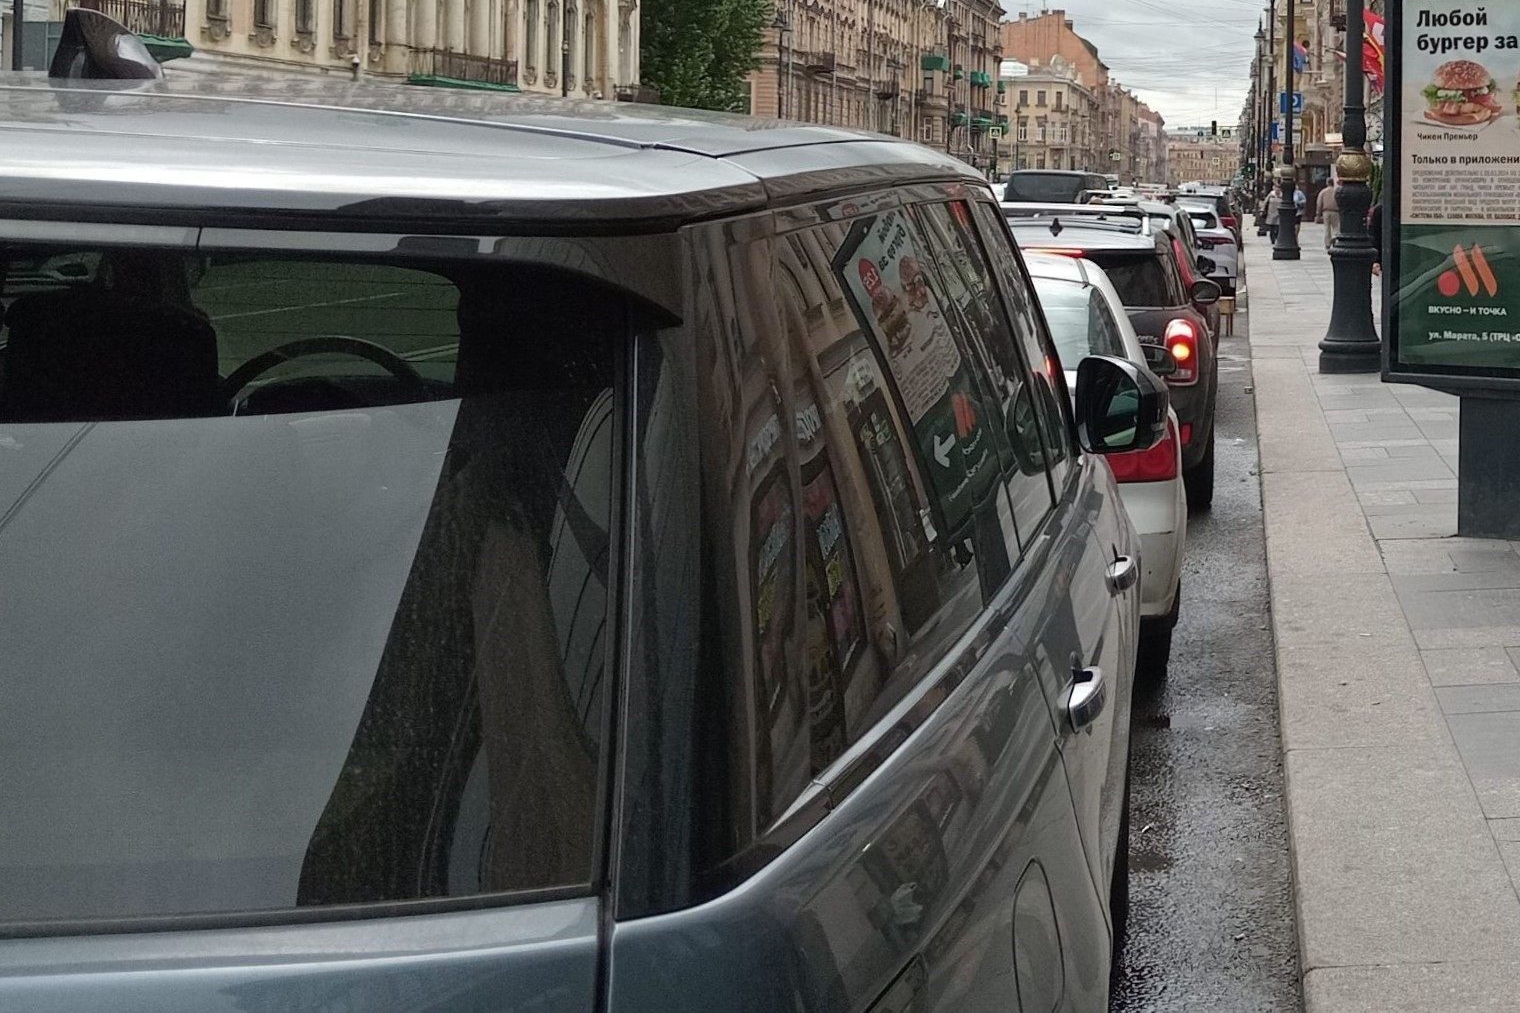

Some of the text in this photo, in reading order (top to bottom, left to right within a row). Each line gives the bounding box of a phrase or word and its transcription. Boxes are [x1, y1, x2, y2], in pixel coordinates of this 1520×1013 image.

[1416, 7, 1488, 28] Любой
[1416, 33, 1519, 55] бургер за
[1417, 132, 1478, 142] Чикен Премьер
[1411, 154, 1448, 165] Только
[1450, 155, 1457, 165] в
[1428, 305, 1462, 315] ВКУСНО
[1470, 307, 1477, 316] И
[1478, 307, 1508, 317] ТОЧКА
[1428, 331, 1442, 341] ул.
[1443, 330, 1481, 343] Марата,
[1482, 331, 1489, 341] 5
[1489, 331, 1511, 343] (ТРЦ
